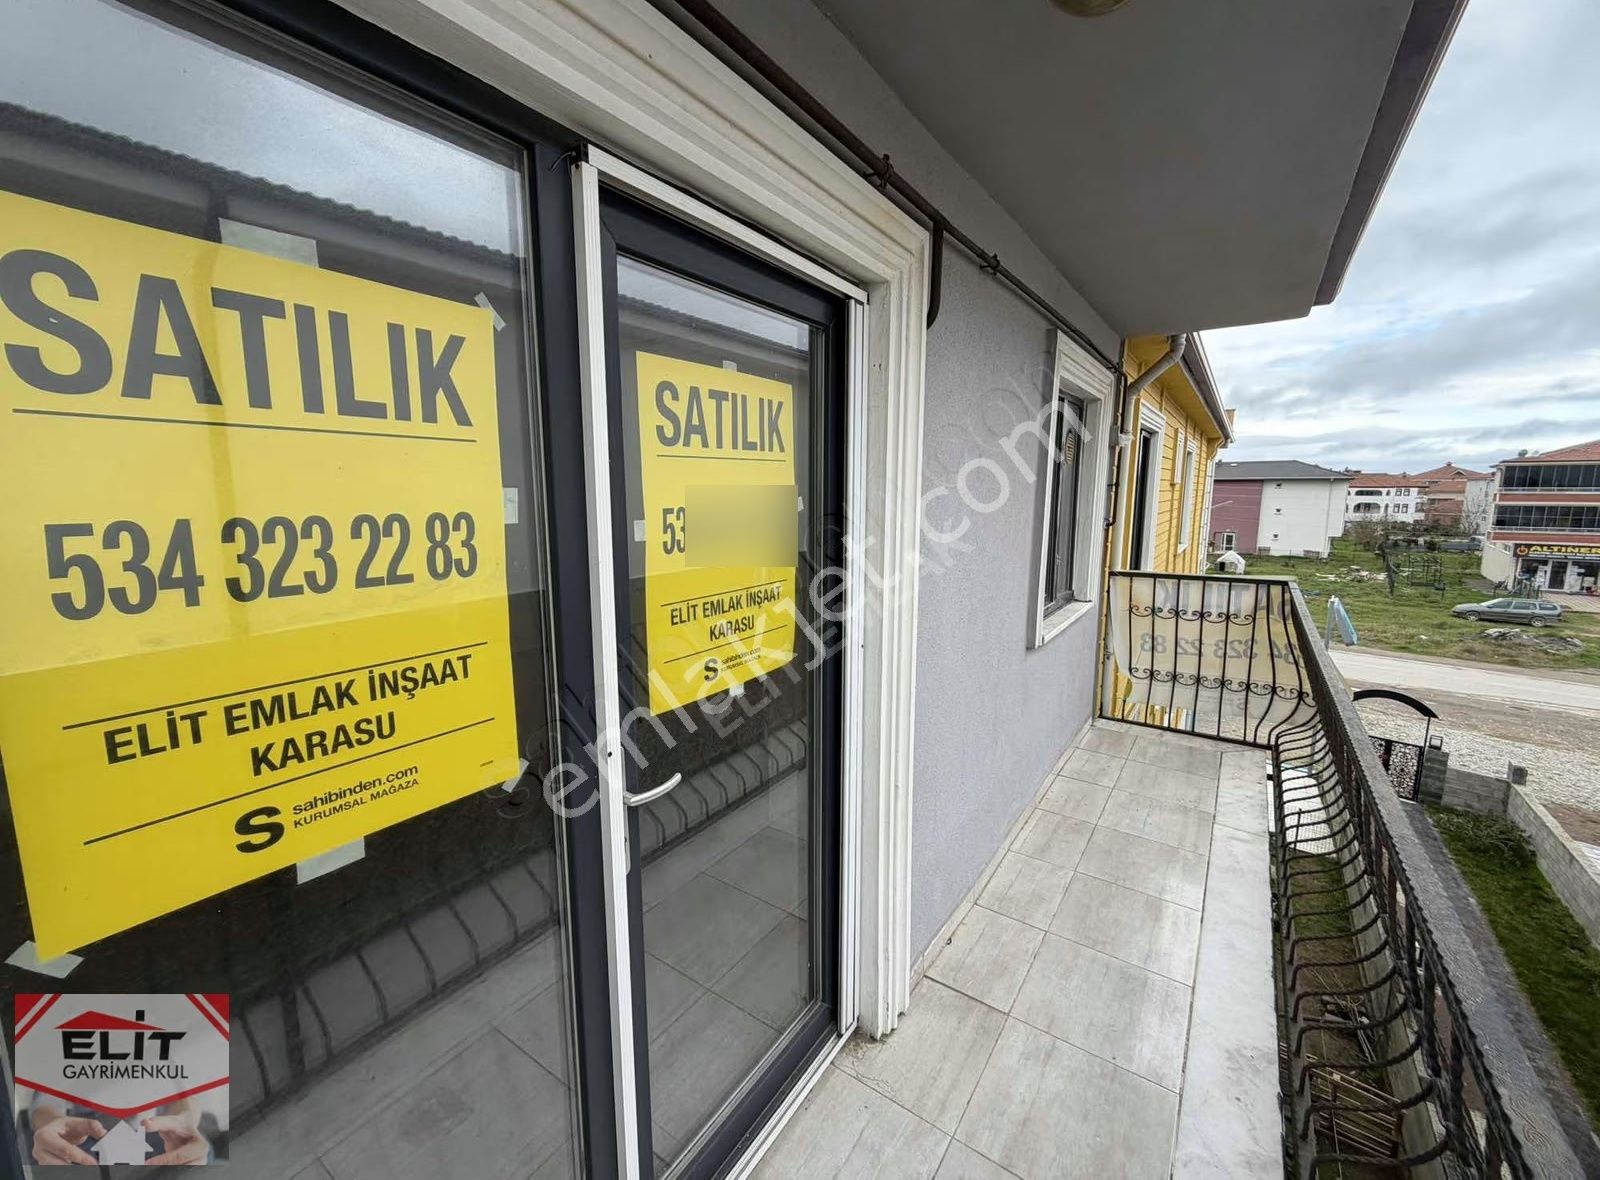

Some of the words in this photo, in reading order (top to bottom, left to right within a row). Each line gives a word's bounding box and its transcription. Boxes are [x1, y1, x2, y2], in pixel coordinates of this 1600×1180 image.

[0, 249, 473, 427] SATILIK
[655, 380, 785, 453] SATILIK
[44, 518, 204, 621] 534
[221, 515, 338, 603] 323
[351, 514, 414, 590] 22
[425, 512, 478, 580] 83
[670, 603, 698, 626] ELİT
[702, 595, 743, 618] EMLAK
[746, 585, 782, 610] İNŞAAT
[709, 615, 755, 641] KARASU
[103, 710, 207, 765] ELİT
[224, 679, 360, 736] EMLAK
[368, 654, 472, 701] İNŞAAT
[251, 711, 397, 777] KARASU
[234, 806, 285, 854] S
[292, 765, 418, 815] sahibinden.com
[294, 797, 368, 828] KURUMSAL
[370, 778, 419, 802] MAĞAZA
